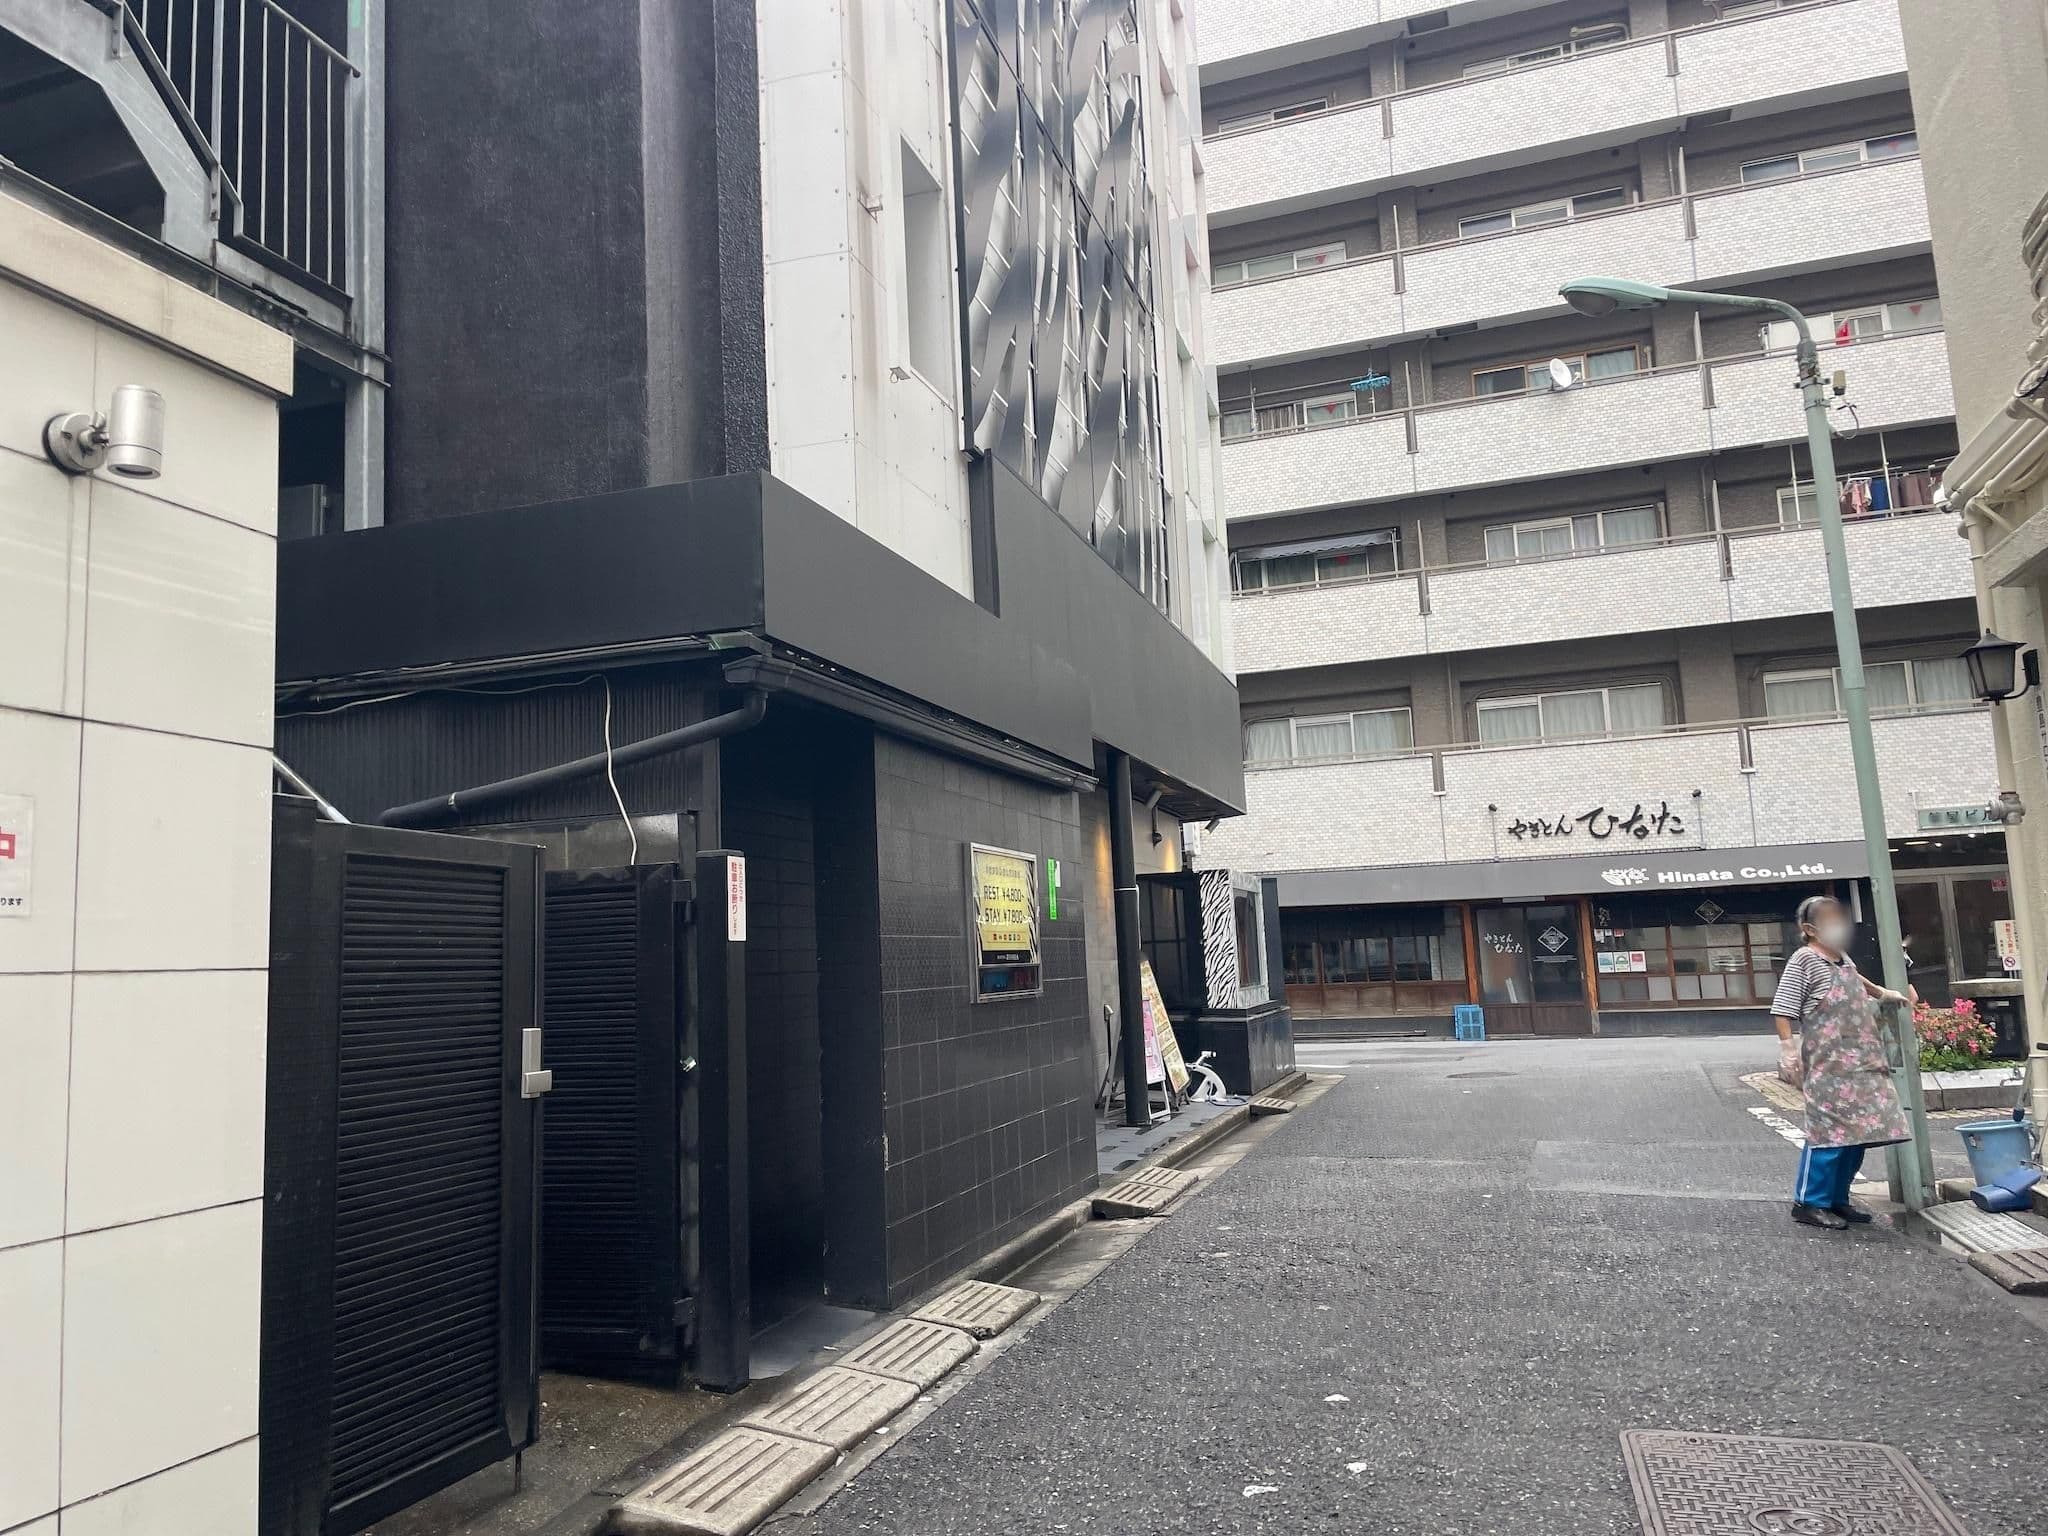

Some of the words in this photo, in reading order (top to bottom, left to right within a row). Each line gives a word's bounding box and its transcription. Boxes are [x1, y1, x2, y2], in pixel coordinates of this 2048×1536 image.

[1576, 801, 1685, 839] ひなた
[1657, 869, 1734, 884] Hinata
[984, 885, 999, 900] REST
[985, 907, 1000, 922] STAY
